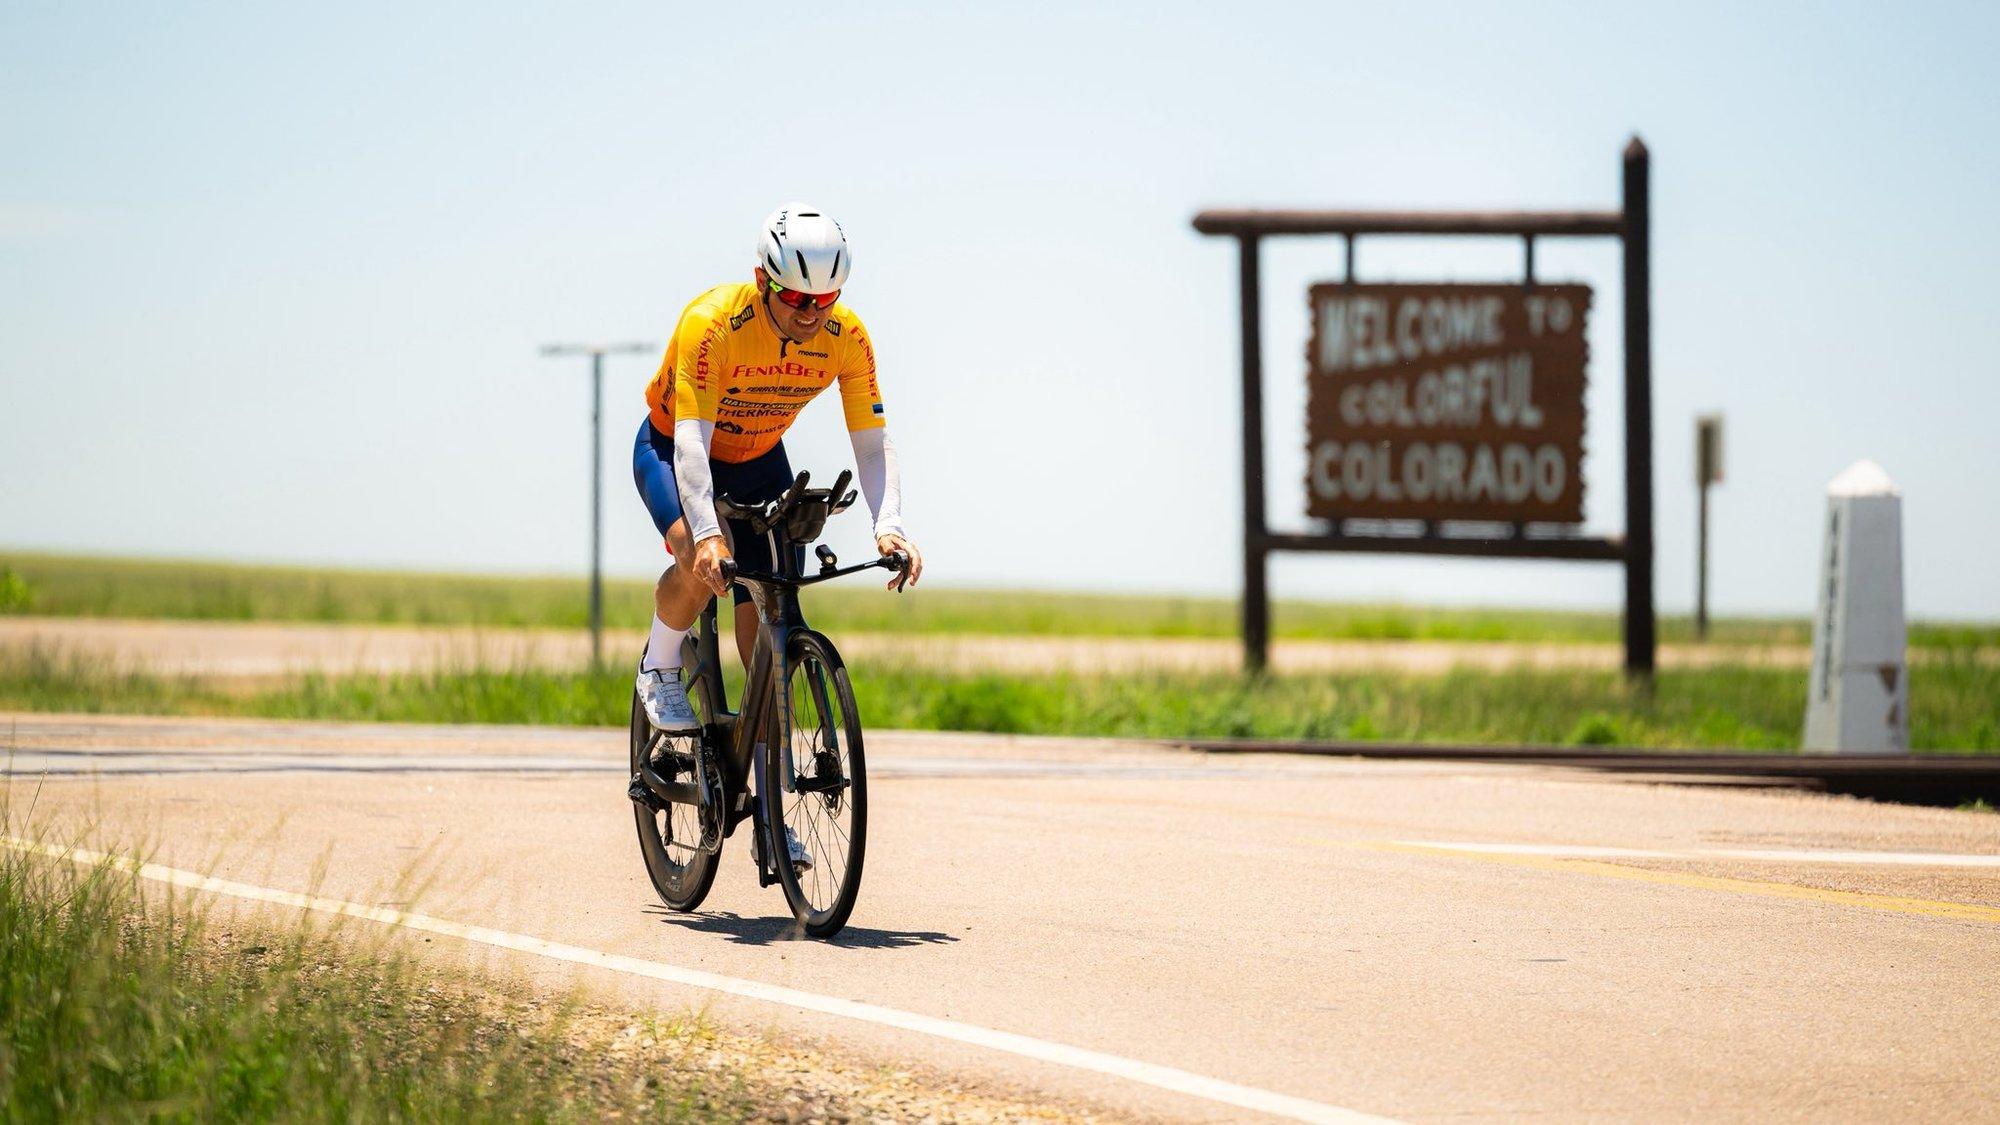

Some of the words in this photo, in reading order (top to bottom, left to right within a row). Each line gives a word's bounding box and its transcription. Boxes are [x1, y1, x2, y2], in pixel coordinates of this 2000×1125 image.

[797, 350, 829, 359] moomoo
[1320, 297, 1504, 375] WELCOME
[1525, 297, 1573, 336] TO
[1340, 352, 1544, 428] COLORFUL
[1311, 441, 1567, 502] COLORADO
